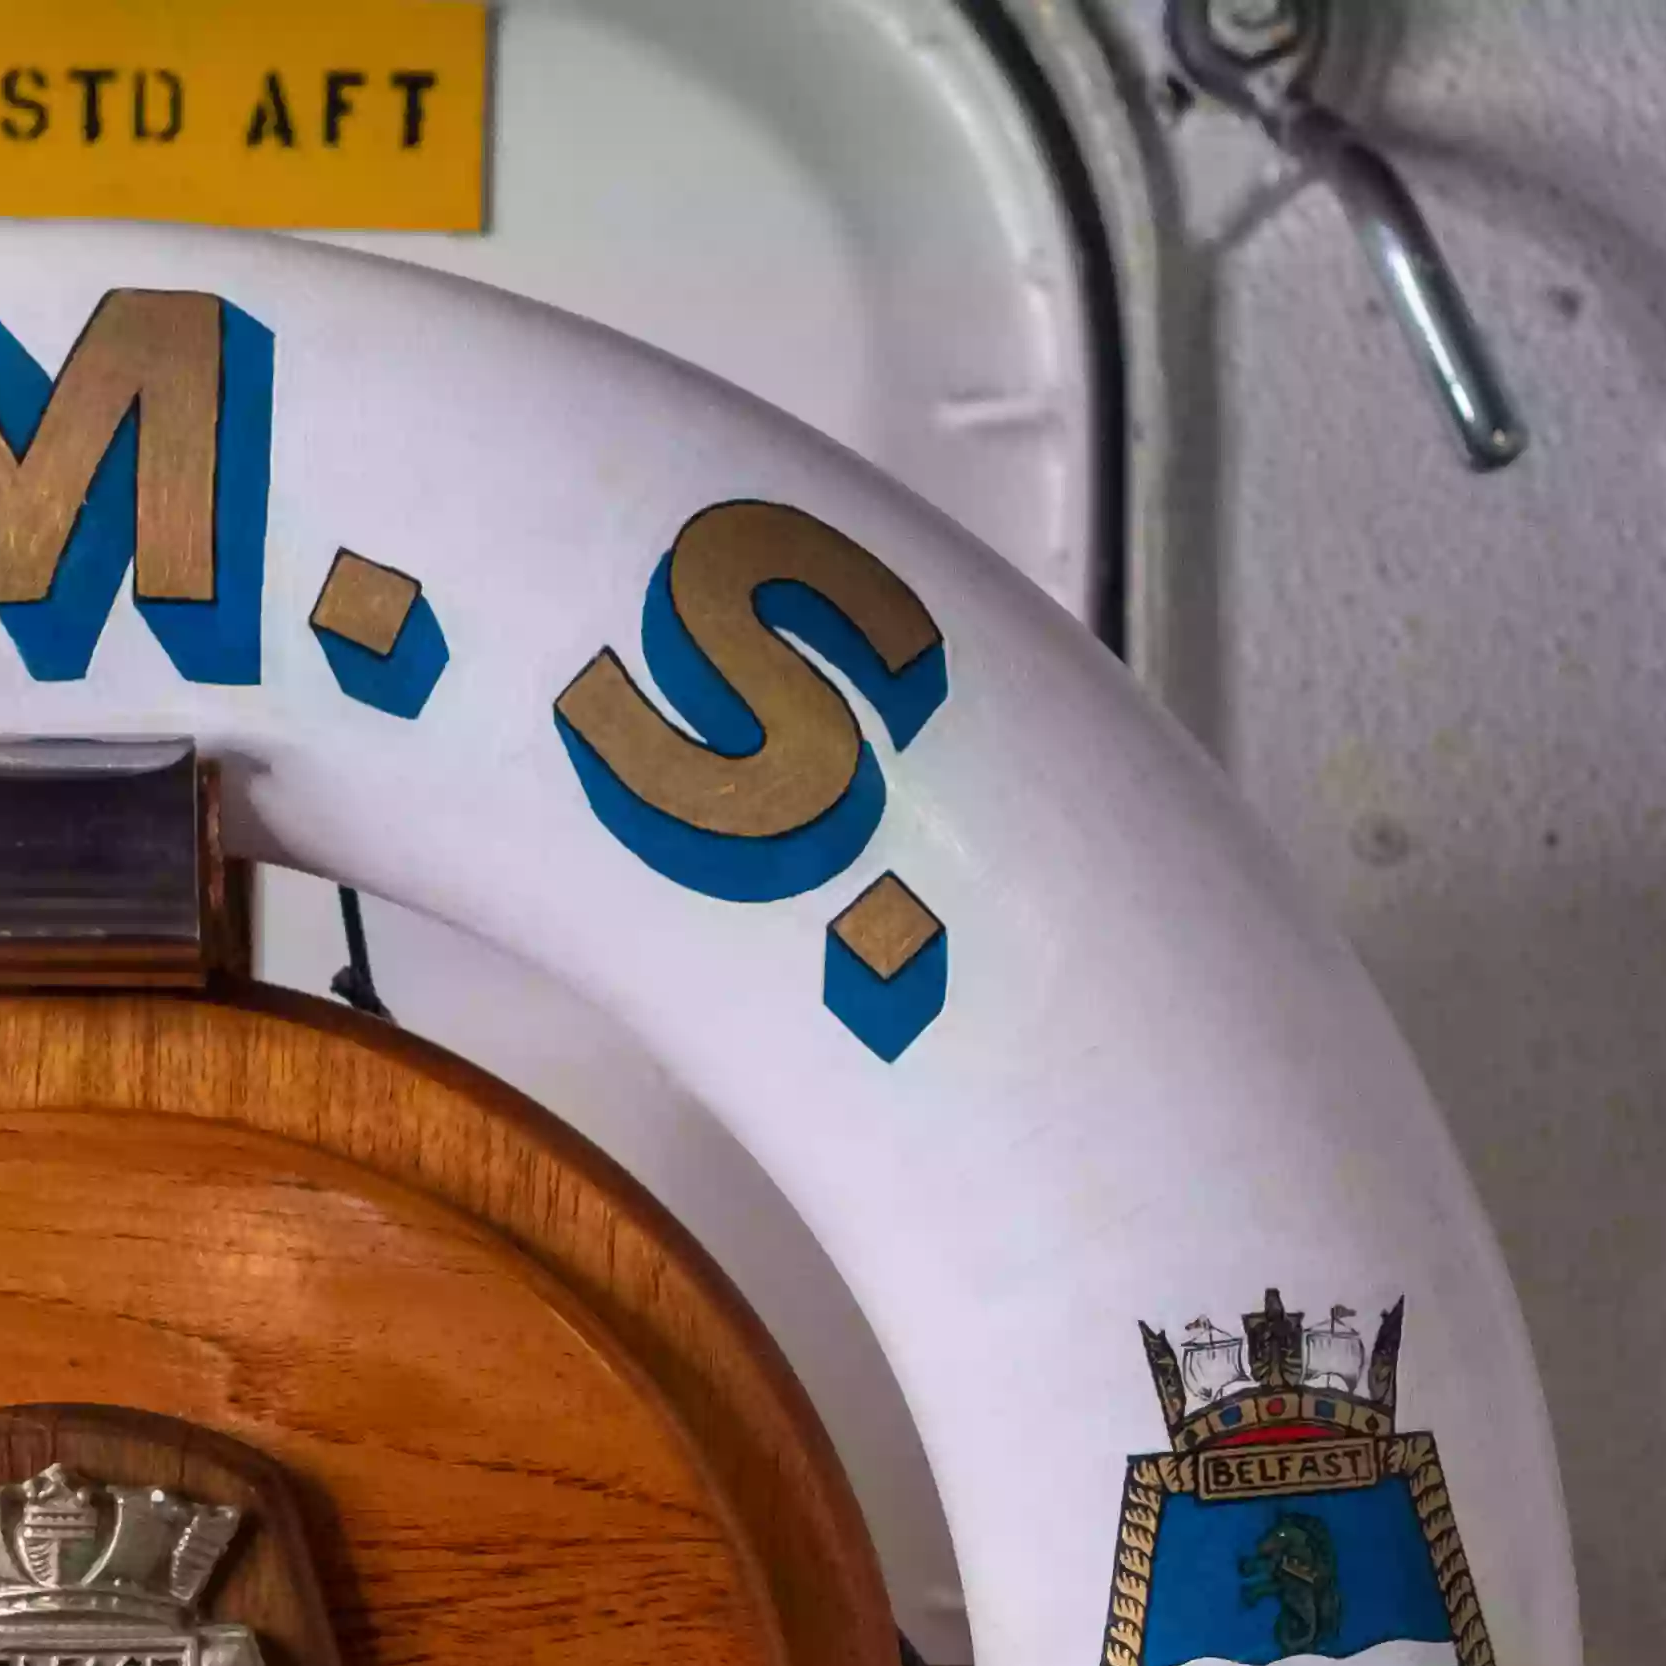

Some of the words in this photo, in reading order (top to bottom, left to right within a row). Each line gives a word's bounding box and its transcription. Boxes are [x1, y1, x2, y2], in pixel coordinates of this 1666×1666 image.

[0, 66, 185, 144] STD
[245, 69, 440, 150] AFT
[1212, 1448, 1366, 1487] BELFAST
